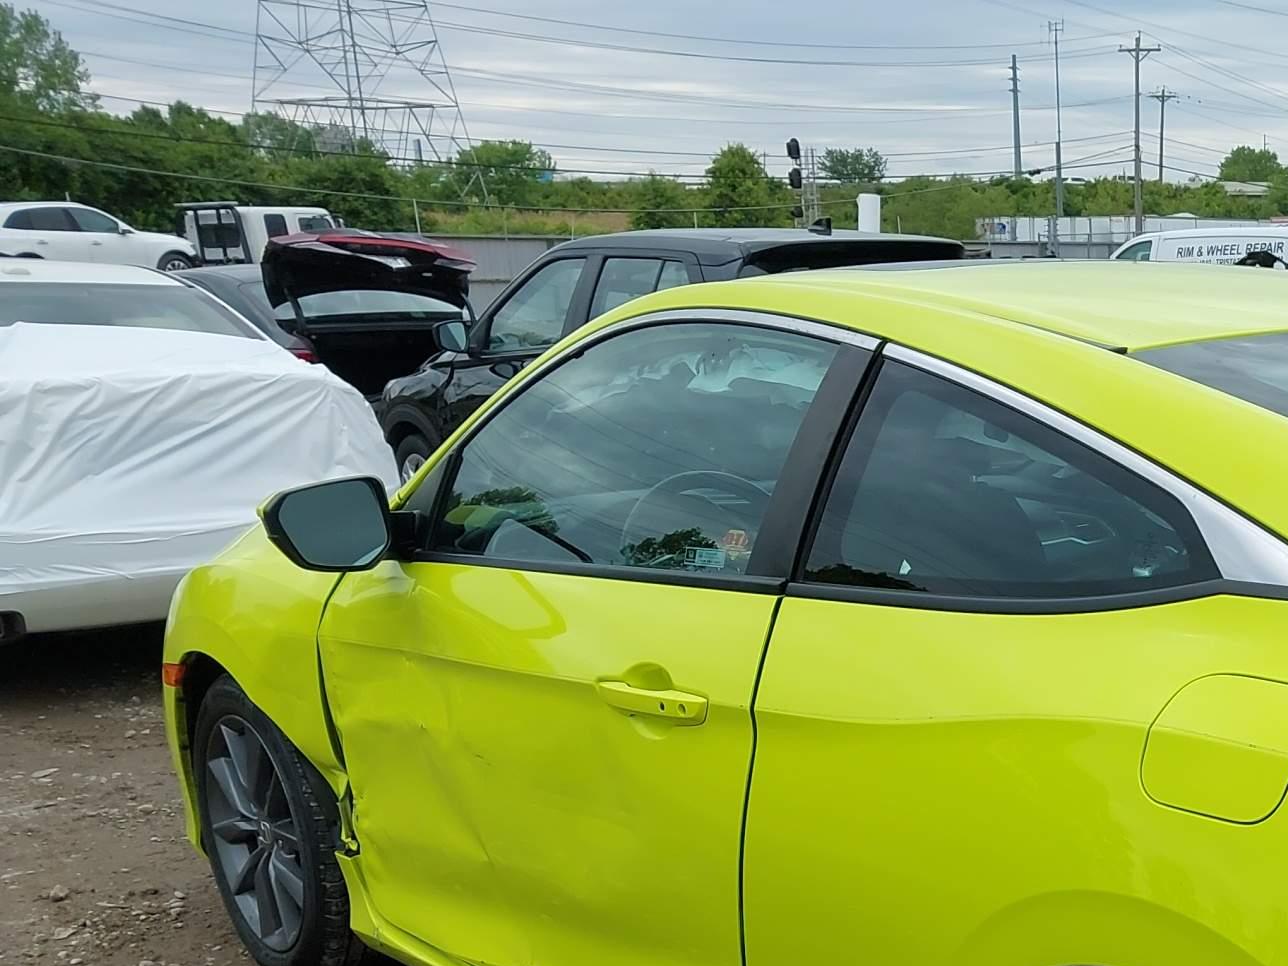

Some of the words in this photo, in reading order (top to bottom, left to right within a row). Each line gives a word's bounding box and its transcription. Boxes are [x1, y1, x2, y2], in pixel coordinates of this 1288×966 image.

[1176, 247, 1194, 258] RIM
[1197, 246, 1203, 257] &
[1207, 244, 1242, 256] WHEEL
[1246, 242, 1284, 254] REPAIR
